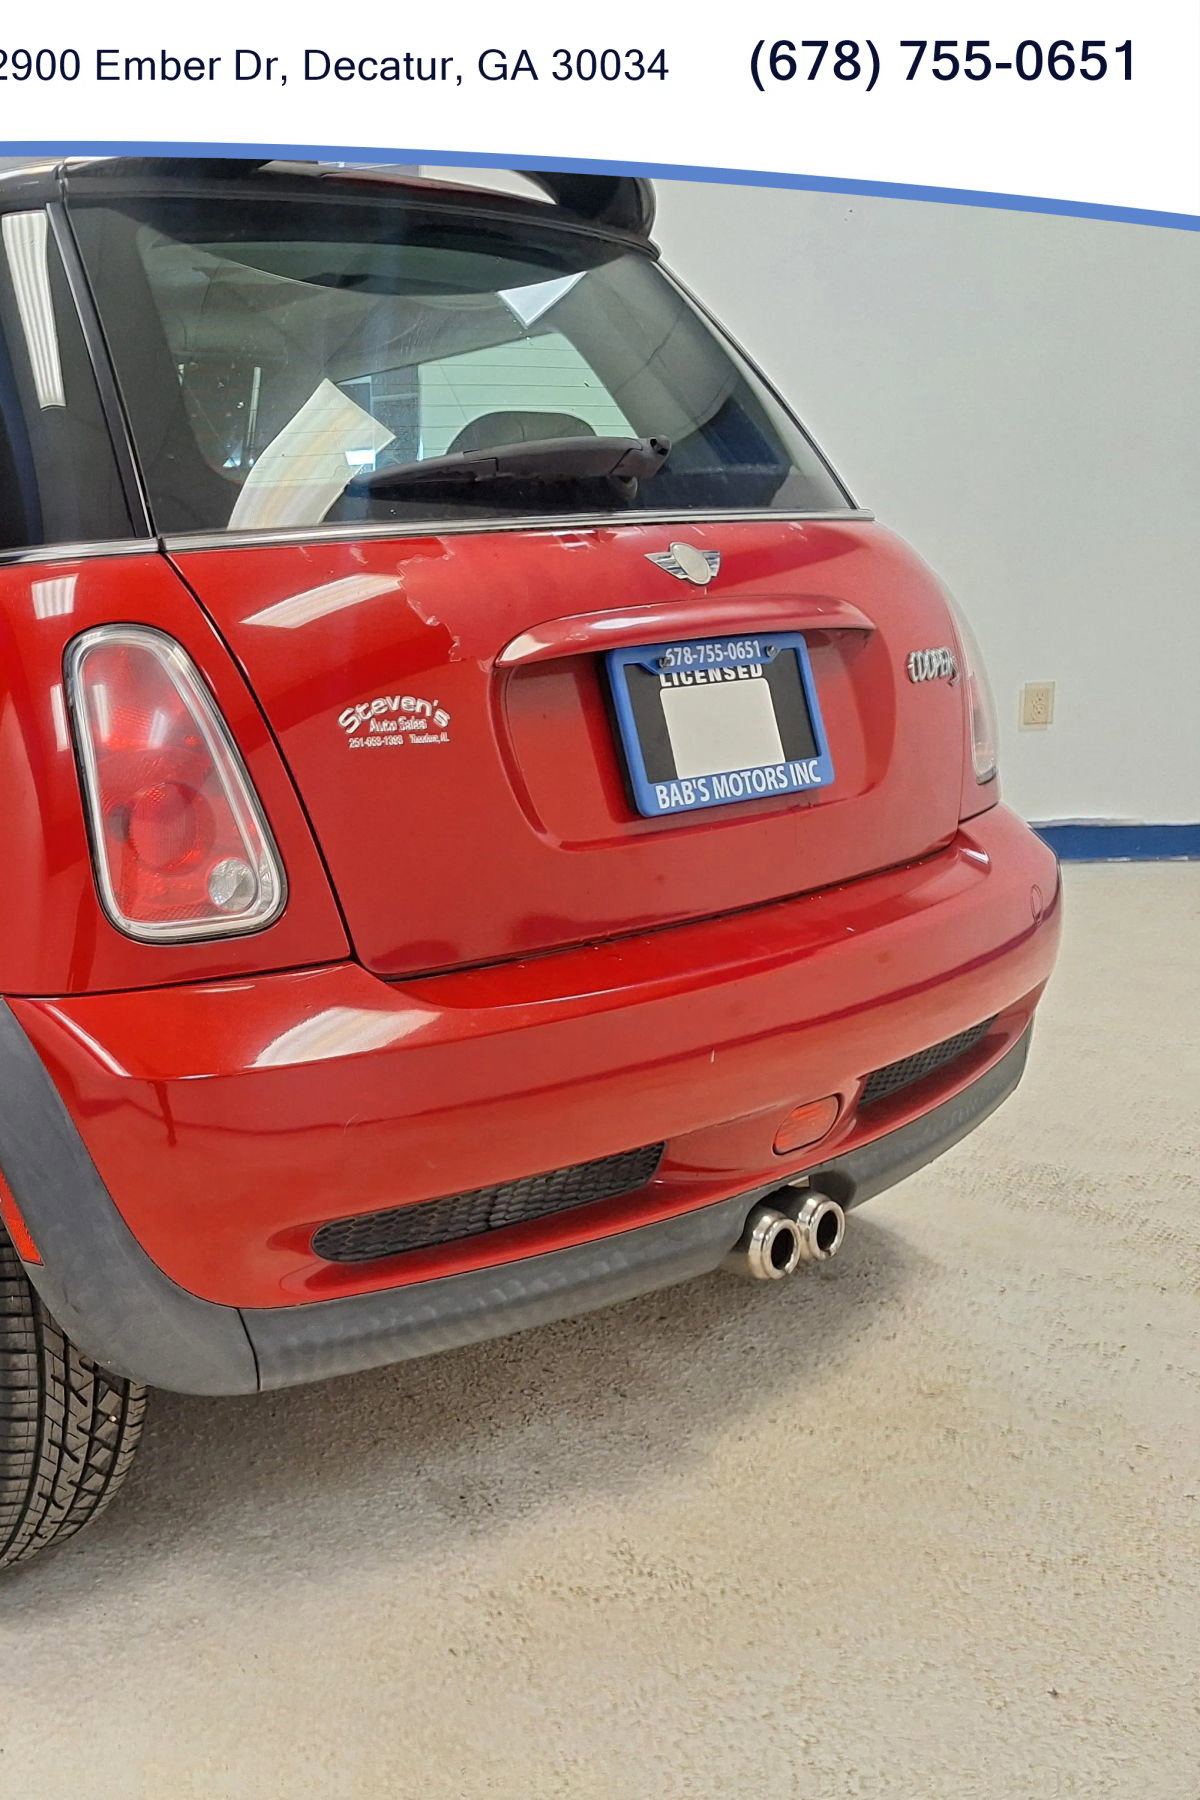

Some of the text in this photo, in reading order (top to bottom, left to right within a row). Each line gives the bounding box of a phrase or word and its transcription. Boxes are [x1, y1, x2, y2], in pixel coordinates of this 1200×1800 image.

[660, 664, 763, 687] LICENSED
[338, 695, 450, 734] Steven's
[369, 716, 428, 733] Auto Sales
[655, 760, 822, 809] BAB'S MOTORS INC
